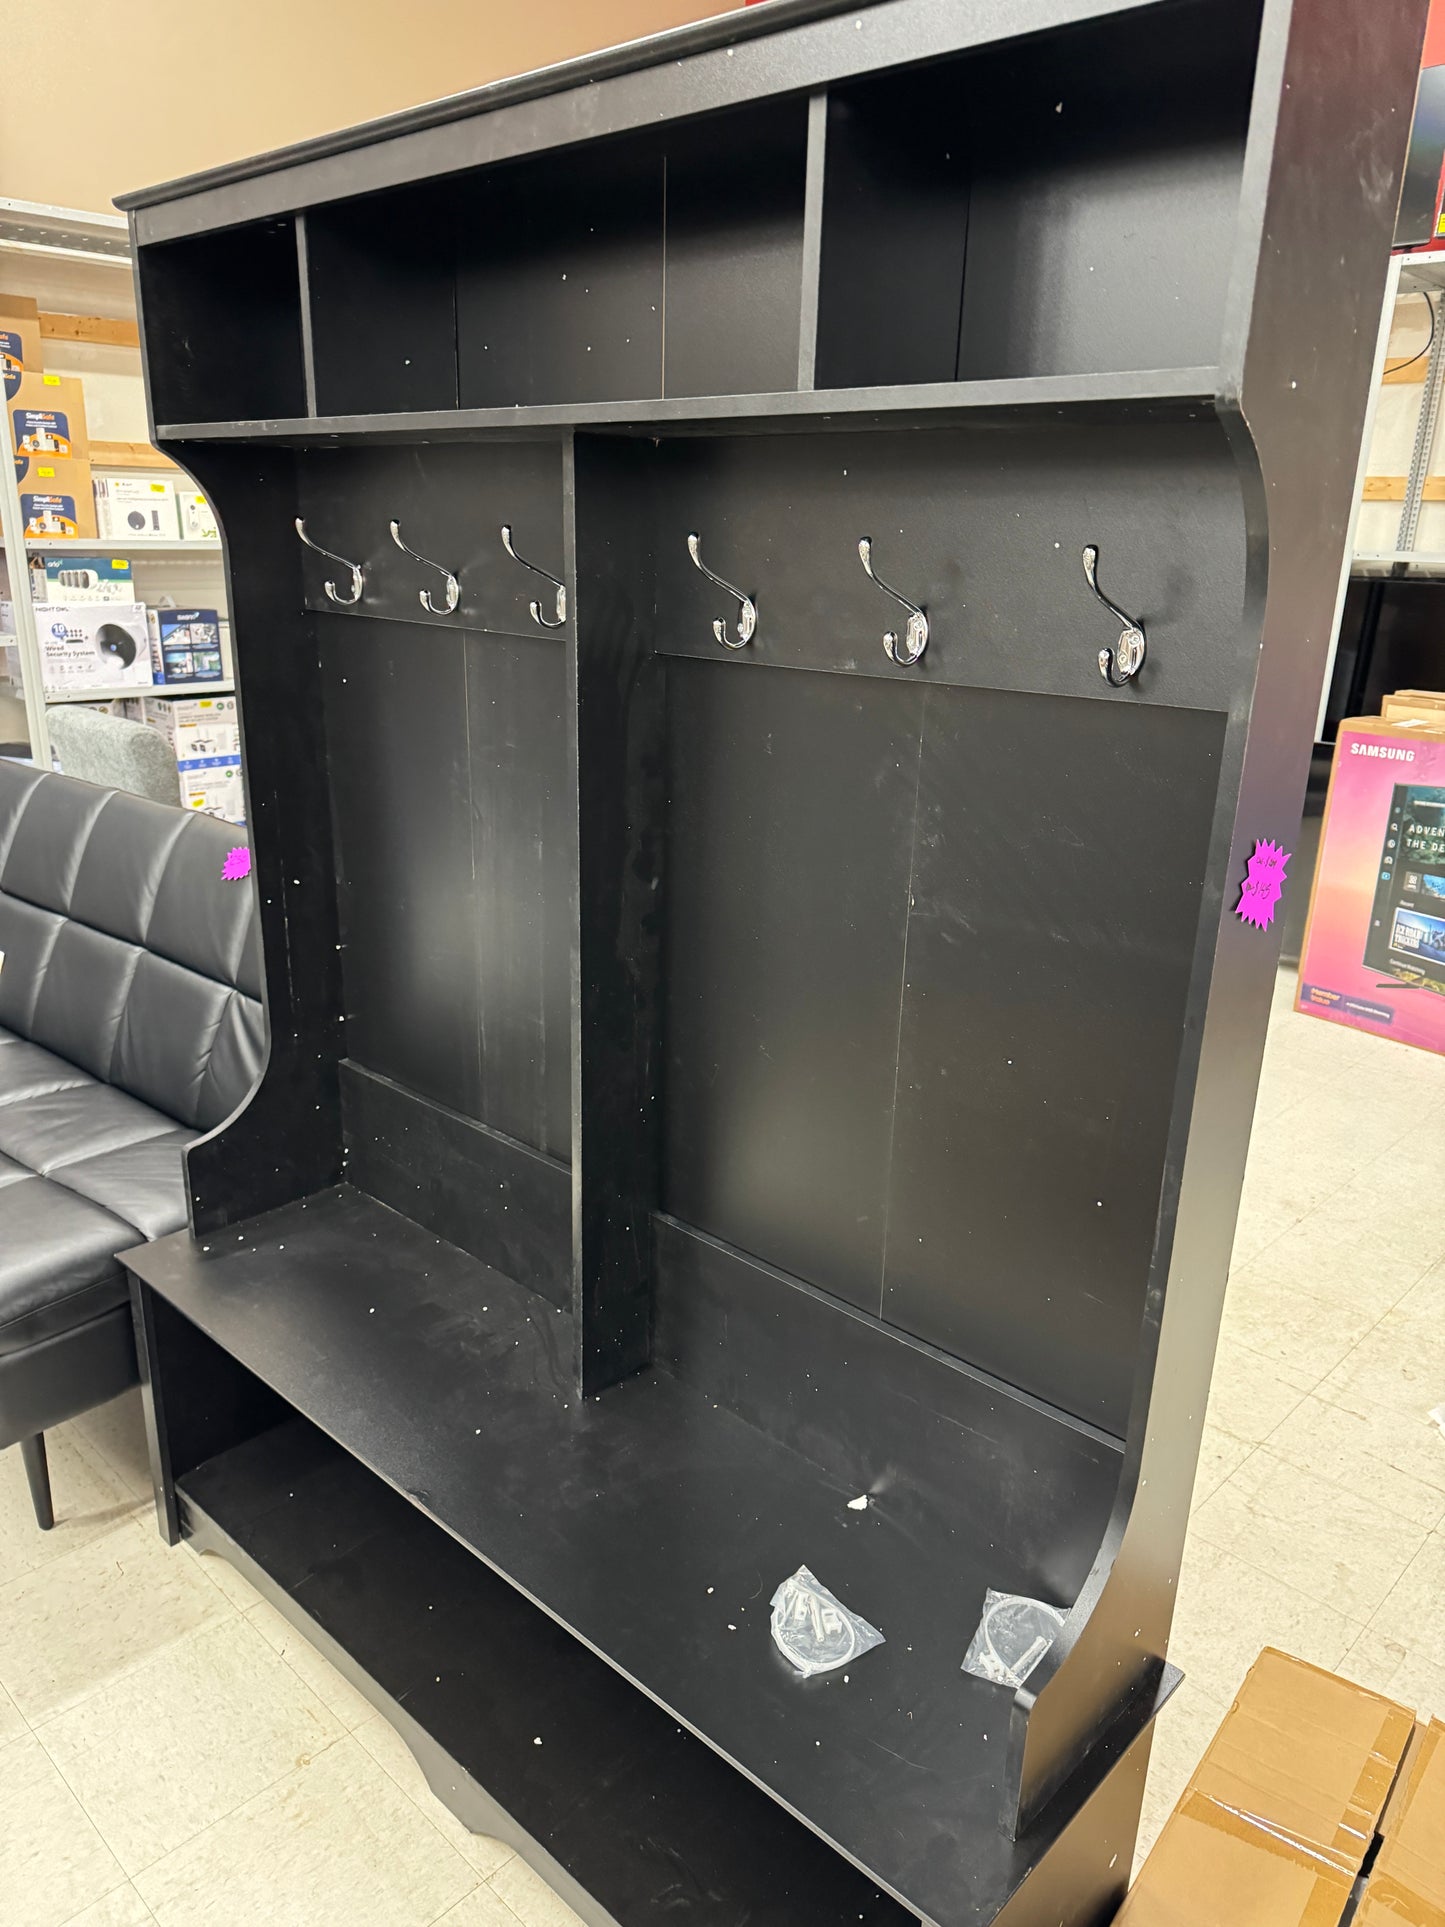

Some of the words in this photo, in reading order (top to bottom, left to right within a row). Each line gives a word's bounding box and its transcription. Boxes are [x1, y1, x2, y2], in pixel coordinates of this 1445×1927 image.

[53, 624, 64, 632] 10
[46, 650, 72, 658] Security
[1350, 743, 1416, 762] SAMSUNG
[1408, 824, 1445, 837] ADVEN
[1406, 838, 1427, 850] THE
[1431, 842, 1445, 853] DE
[1310, 987, 1341, 1001] Member
